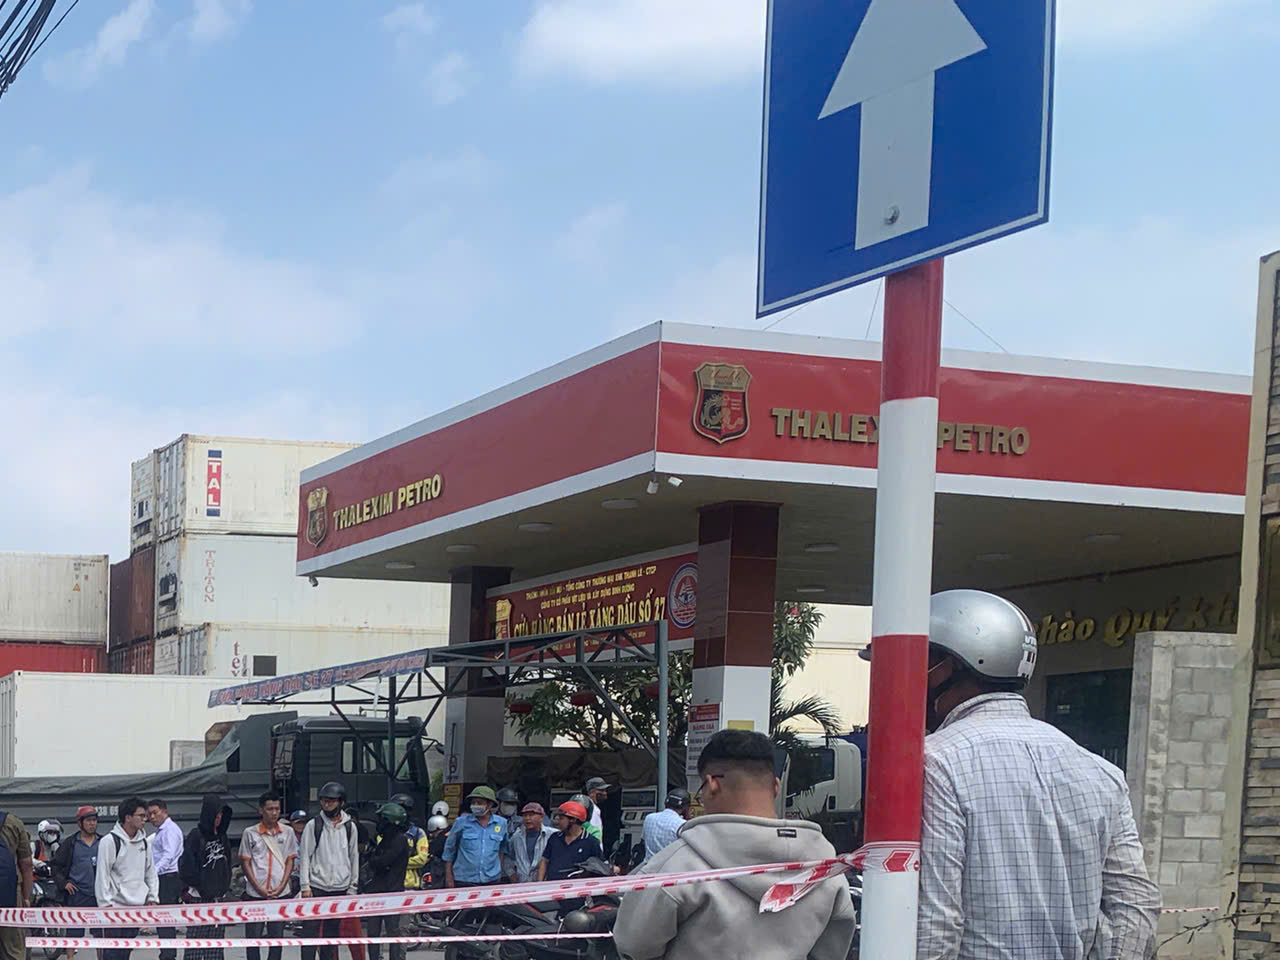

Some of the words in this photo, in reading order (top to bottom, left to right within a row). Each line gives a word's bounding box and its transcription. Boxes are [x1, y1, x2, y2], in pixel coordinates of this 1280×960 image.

[771, 408, 879, 444] THALEX
[937, 421, 1030, 456] PETRO
[208, 461, 220, 506] TAL
[332, 495, 394, 532] THALEXIM
[397, 473, 442, 510] PETRO
[204, 550, 216, 602] TRITON
[556, 609, 575, 633] BÁN
[589, 602, 614, 629] XĂNG
[617, 594, 637, 626] DẦU
[638, 588, 654, 623] SỐ
[654, 596, 666, 621] 27
